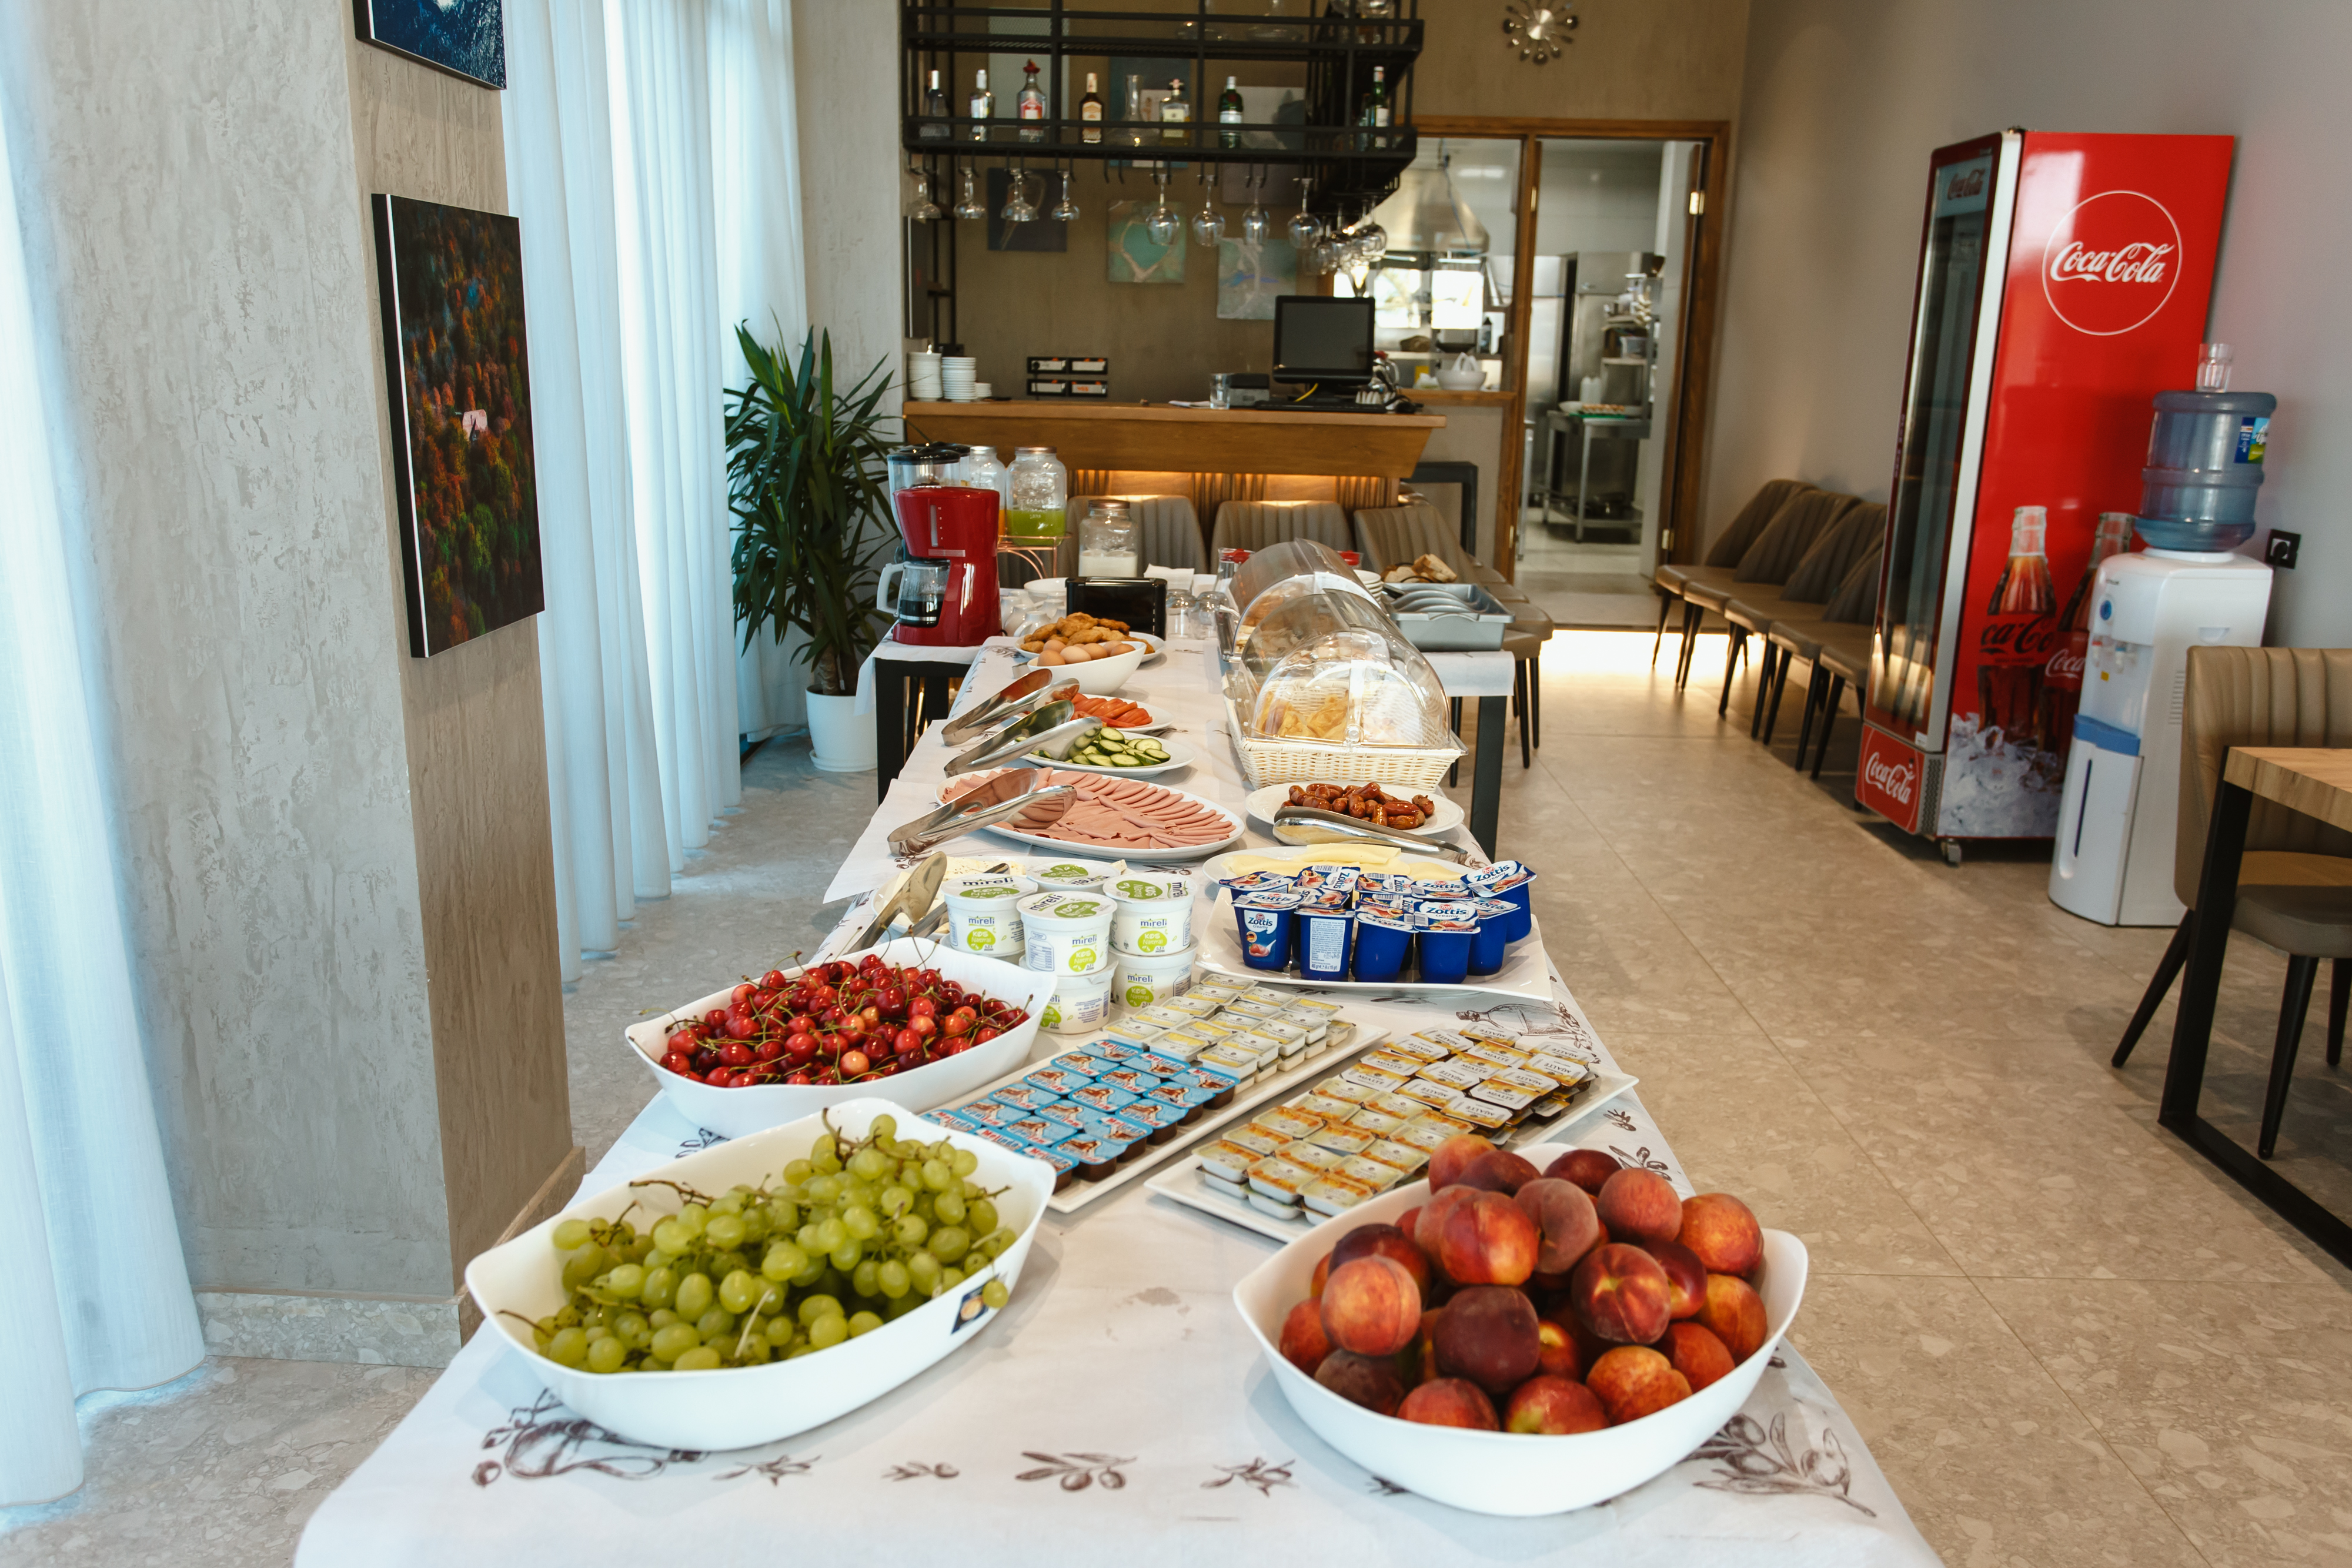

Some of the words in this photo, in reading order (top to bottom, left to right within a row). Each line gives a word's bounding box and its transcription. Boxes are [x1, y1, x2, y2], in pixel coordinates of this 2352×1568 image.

[2050, 240, 2176, 283] Coca-Cola
[1474, 865, 1510, 882] Zottis
[1486, 872, 1506, 882] creamy
[963, 877, 1014, 886] mireli
[1333, 872, 1350, 889] Zottis
[1029, 894, 1063, 911] mireli
[968, 916, 995, 925] mireli
[1140, 918, 1167, 927] mireli
[1248, 917, 1273, 927] Zottis
[1072, 934, 1097, 945] mireli
[1127, 973, 1153, 982] mireli
[1101, 1041, 1135, 1054] Melinda
[1058, 1060, 1094, 1075] Melinda
[1145, 1054, 1182, 1068] Melinda
[1194, 1069, 1232, 1083] Melinda
[982, 1129, 1019, 1146] Melinda
